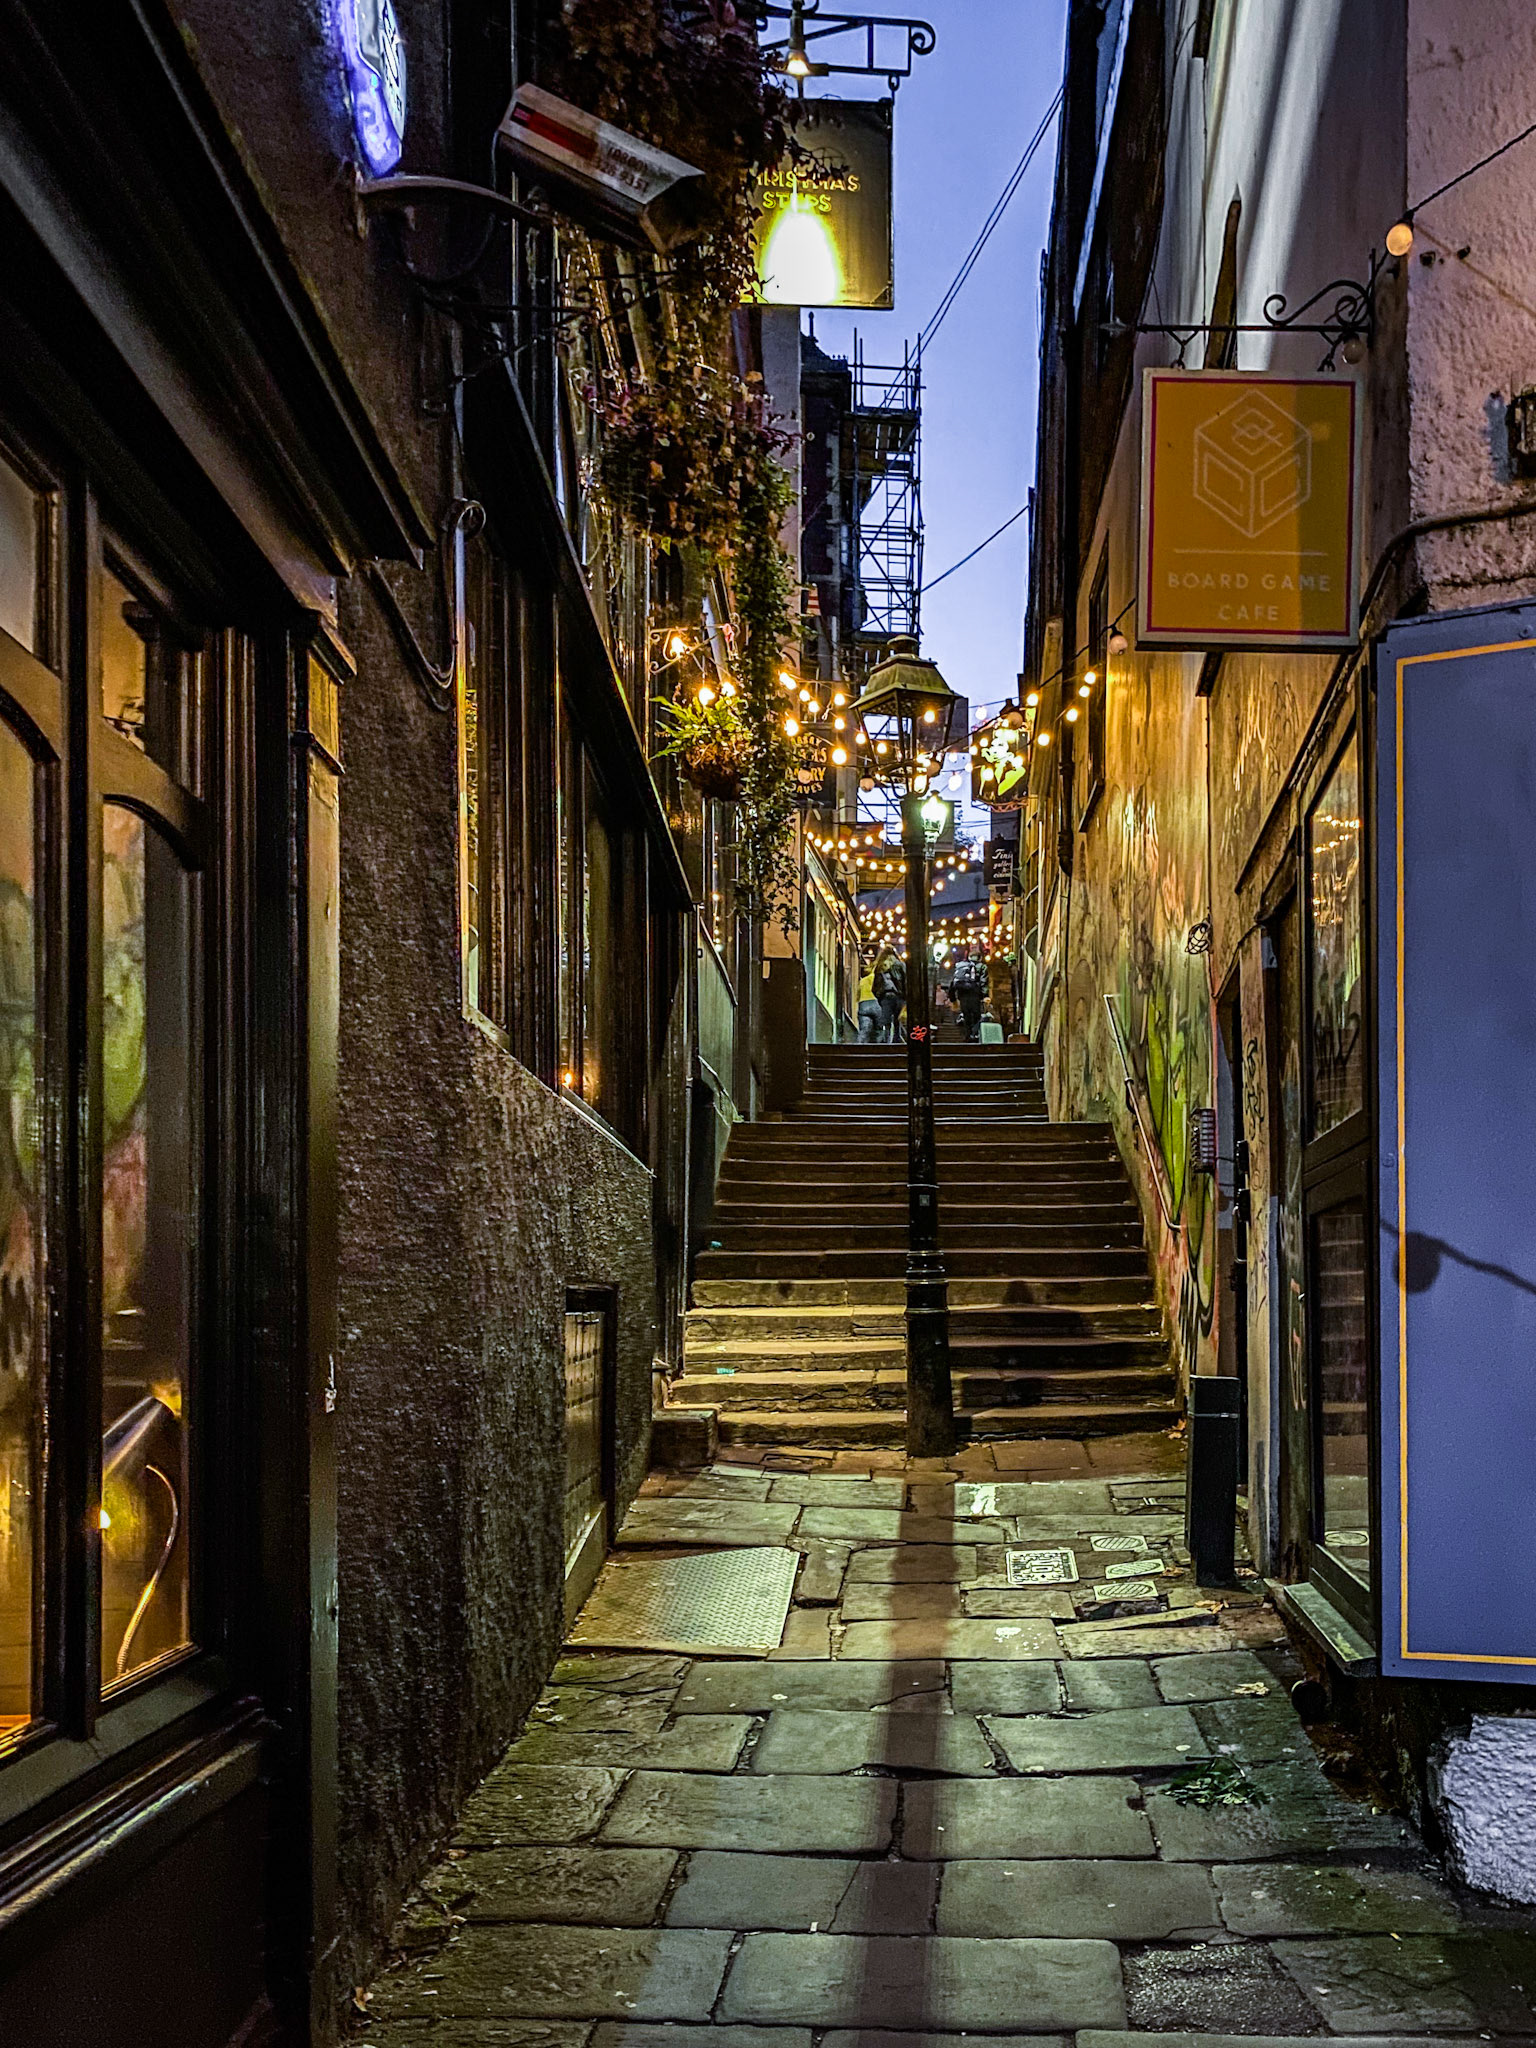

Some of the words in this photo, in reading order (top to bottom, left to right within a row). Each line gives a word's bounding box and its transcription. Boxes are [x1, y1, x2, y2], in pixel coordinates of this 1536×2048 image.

[756, 169, 860, 192] RISTMAS
[1168, 572, 1249, 589] BOARD
[1262, 573, 1330, 591] GAME
[1218, 604, 1278, 621] CAFE
